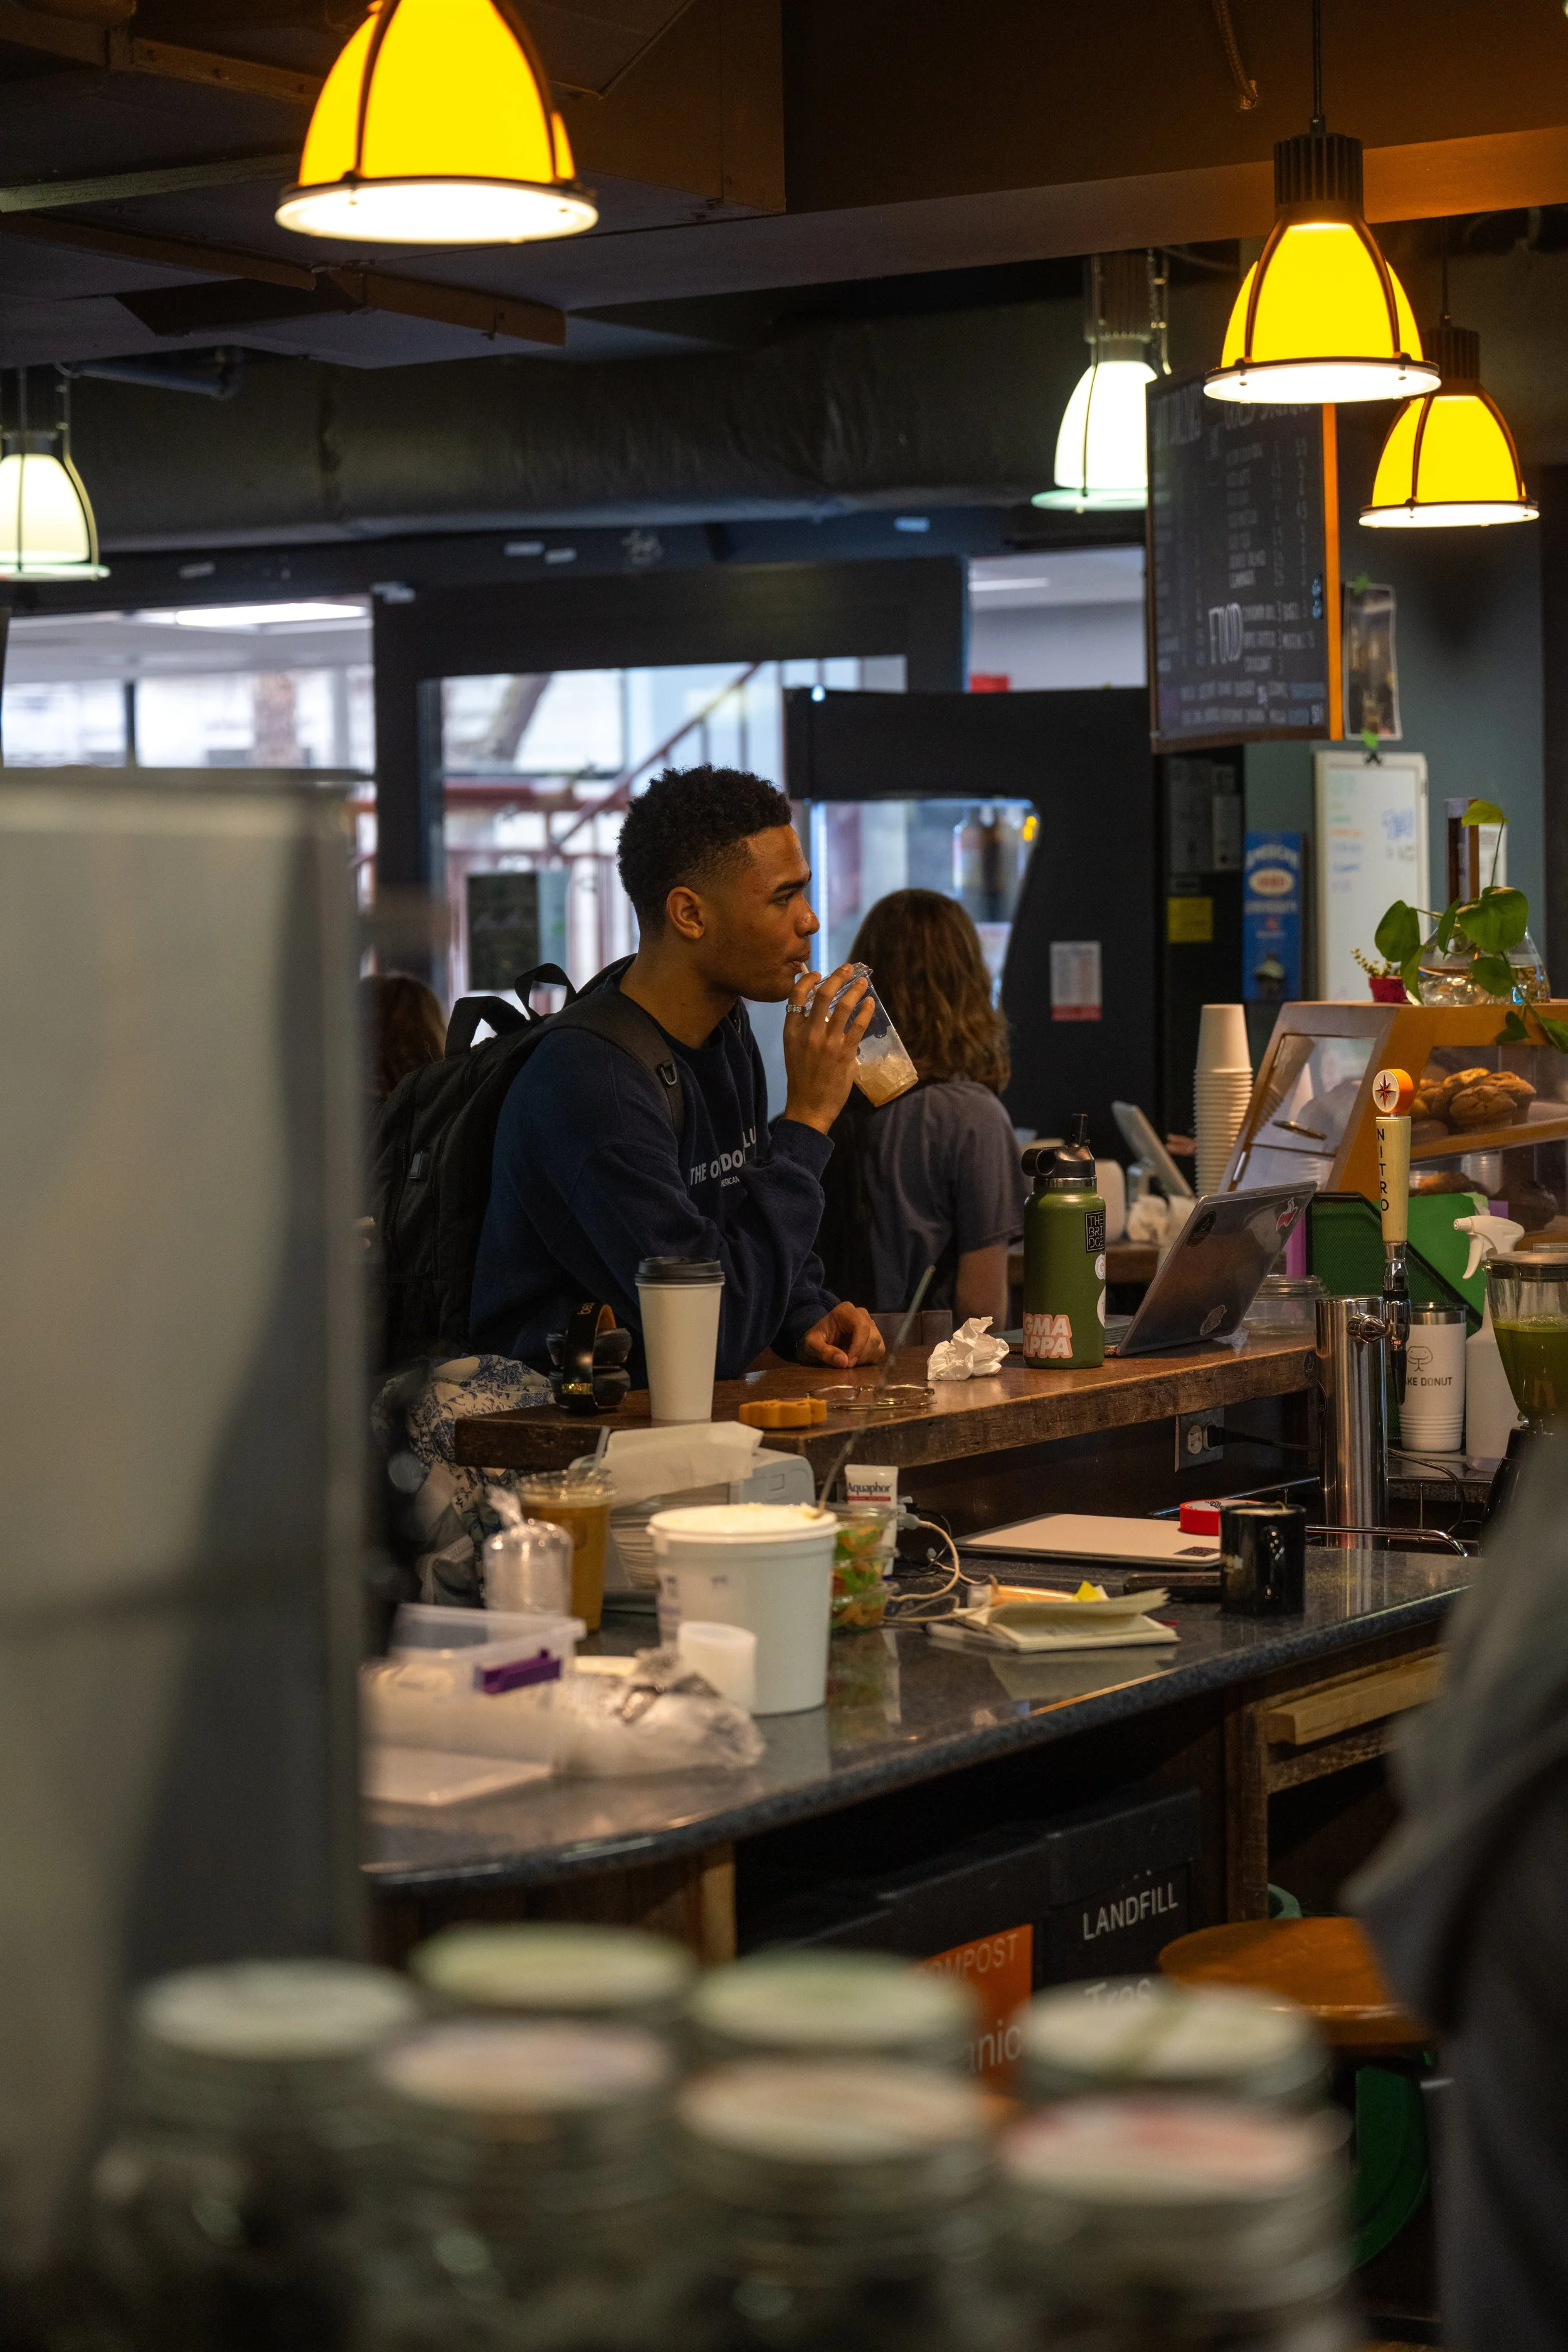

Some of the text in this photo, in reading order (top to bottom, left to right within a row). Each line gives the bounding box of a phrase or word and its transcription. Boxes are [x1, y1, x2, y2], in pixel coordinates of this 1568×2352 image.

[690, 1162, 707, 1185] THE
[1377, 1128, 1389, 1212] NITRO
[1088, 1214, 1103, 1226] THE
[1421, 1377, 1453, 1386] DONUT
[847, 1481, 891, 1496] Aquaphor
[1083, 1882, 1179, 1941] LANDFILL
